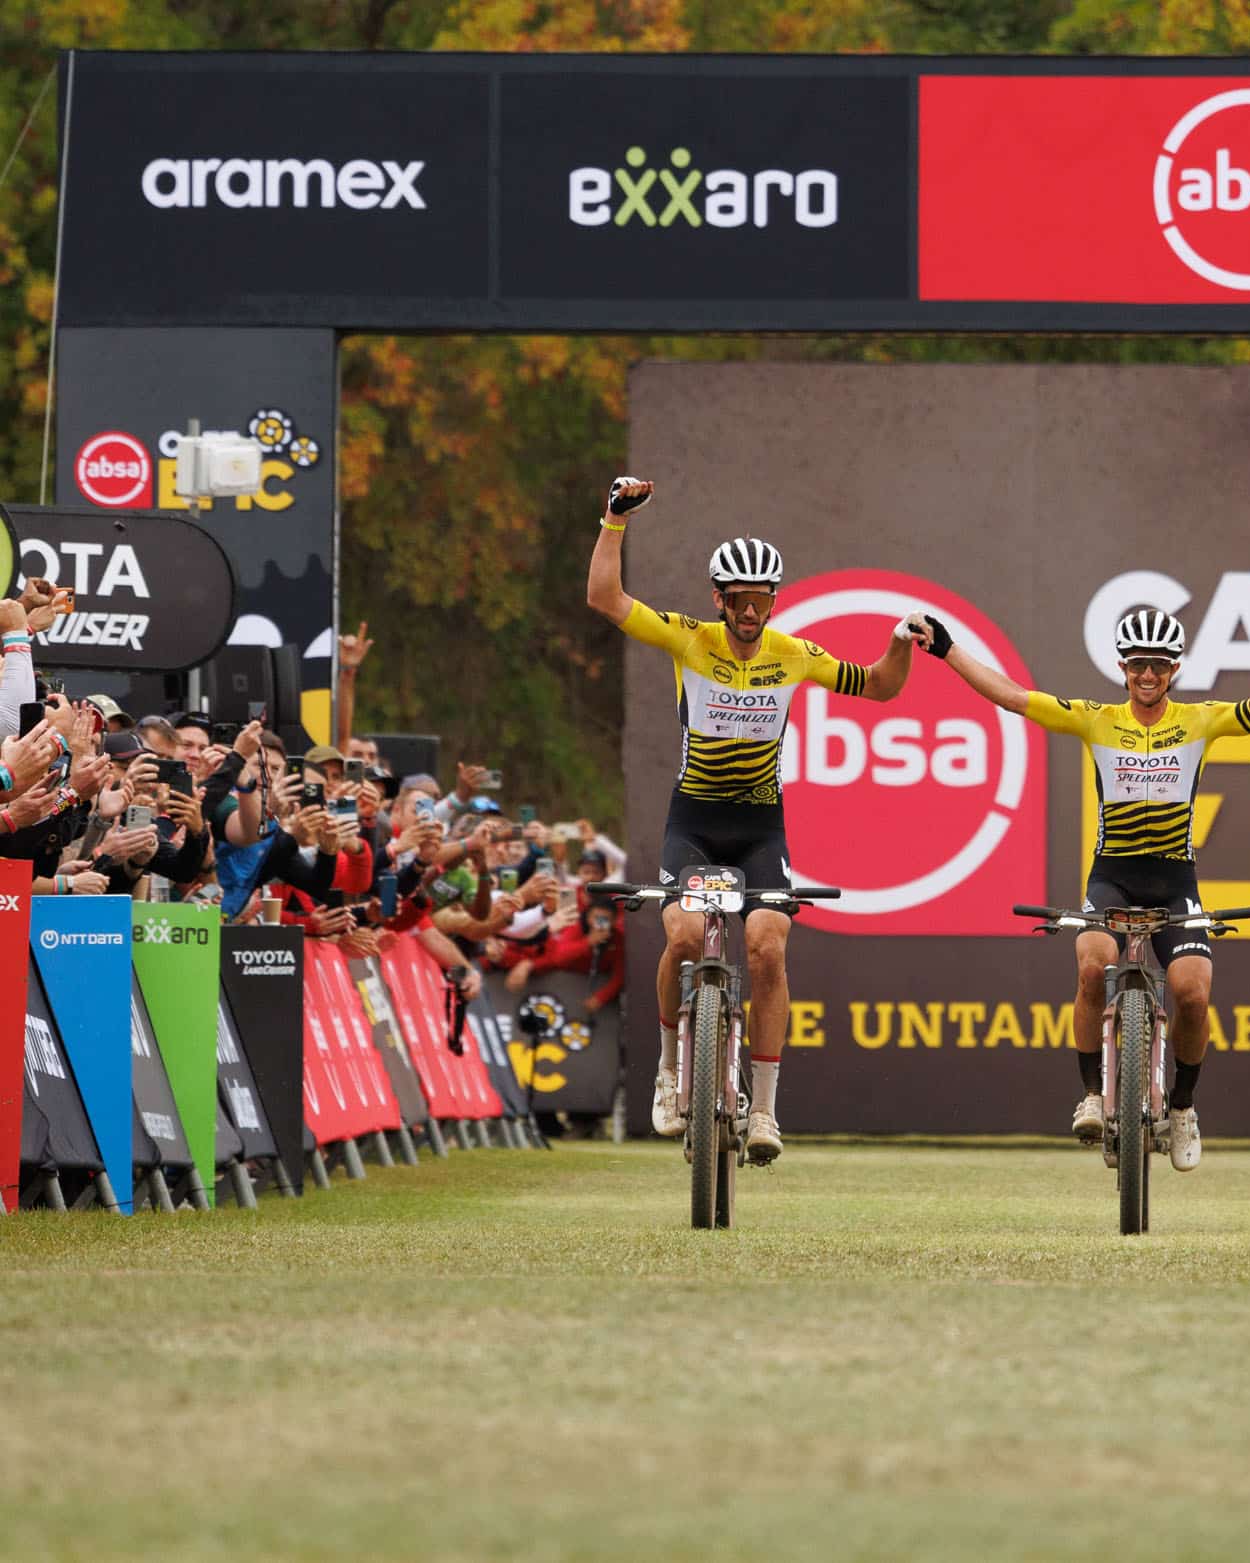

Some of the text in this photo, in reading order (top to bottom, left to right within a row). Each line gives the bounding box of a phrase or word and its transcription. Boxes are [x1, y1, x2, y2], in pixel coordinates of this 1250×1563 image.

[141, 158, 426, 210] aramex
[569, 147, 838, 228] exxaro
[87, 455, 139, 478] absa
[709, 689, 777, 707] TOYOTA
[784, 686, 988, 787] bsa
[1116, 755, 1179, 768] TOYOTA
[232, 950, 295, 965] TOYOTA
[849, 1001, 1078, 1050] UNTAM
